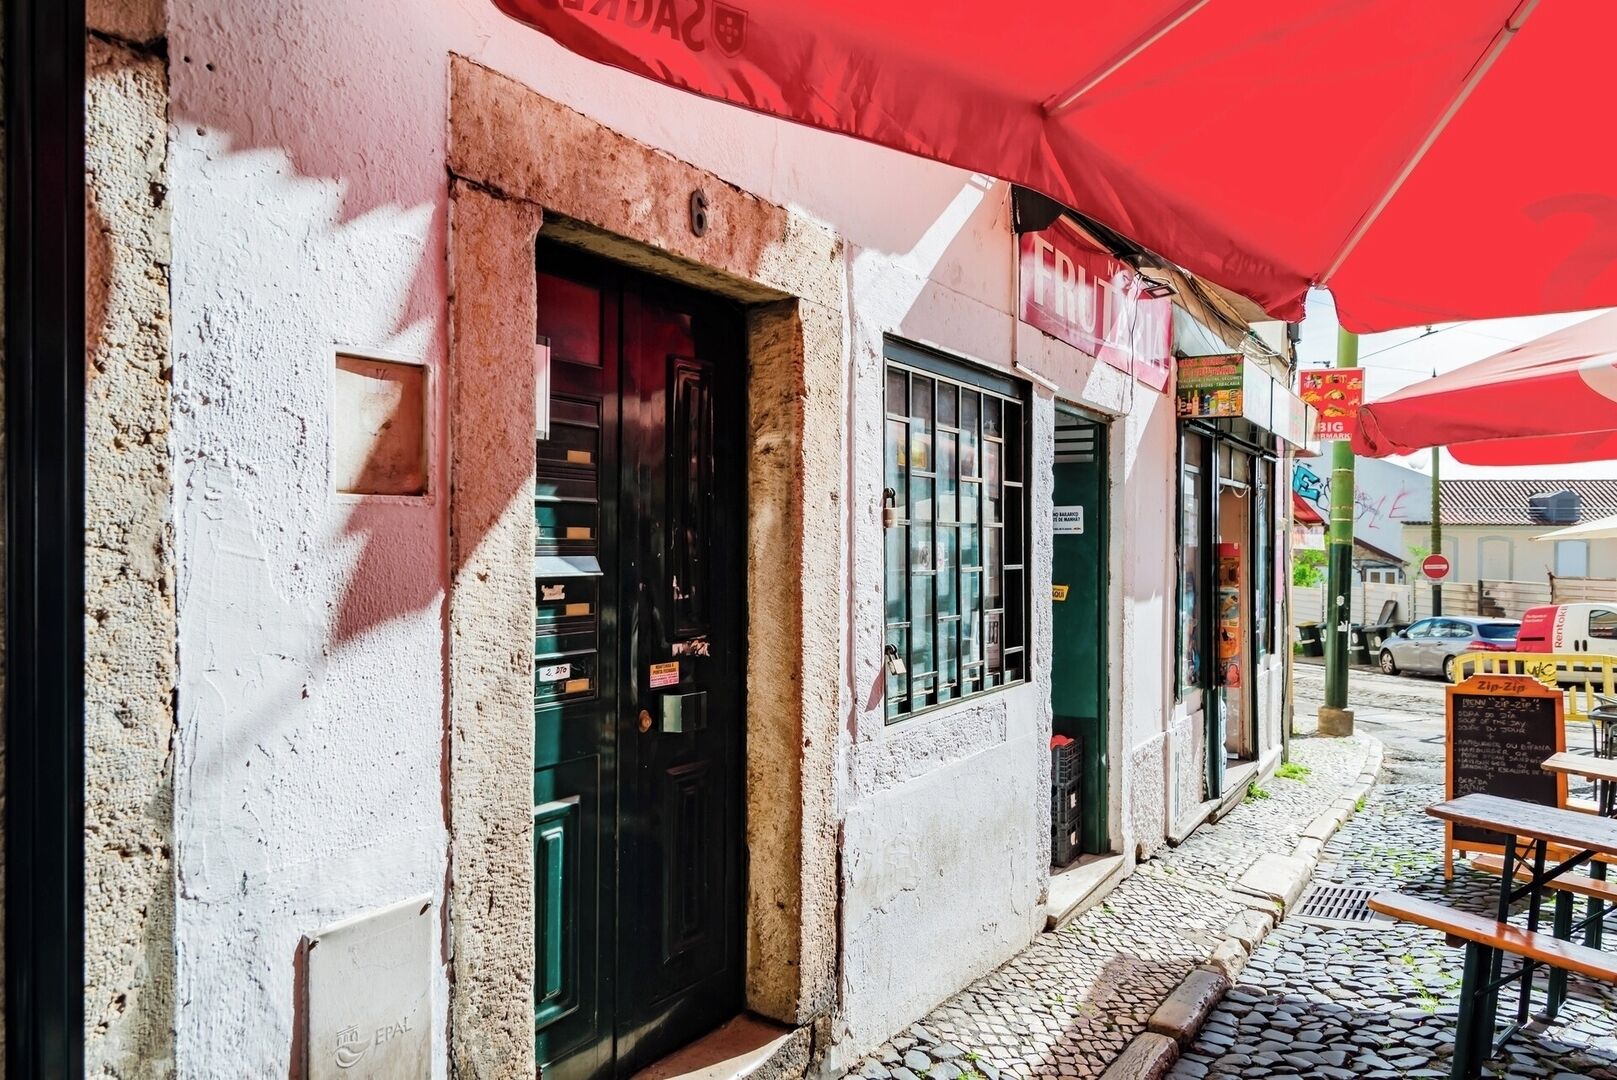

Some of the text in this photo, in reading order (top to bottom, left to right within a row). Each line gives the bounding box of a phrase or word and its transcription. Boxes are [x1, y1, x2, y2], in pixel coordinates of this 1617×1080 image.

[691, 188, 709, 237] 6
[1033, 231, 1166, 367] FRUTA
[1555, 606, 1568, 648] Rentokil
[1477, 681, 1526, 693] Zip-Zip
[375, 1016, 413, 1045] EPAL
